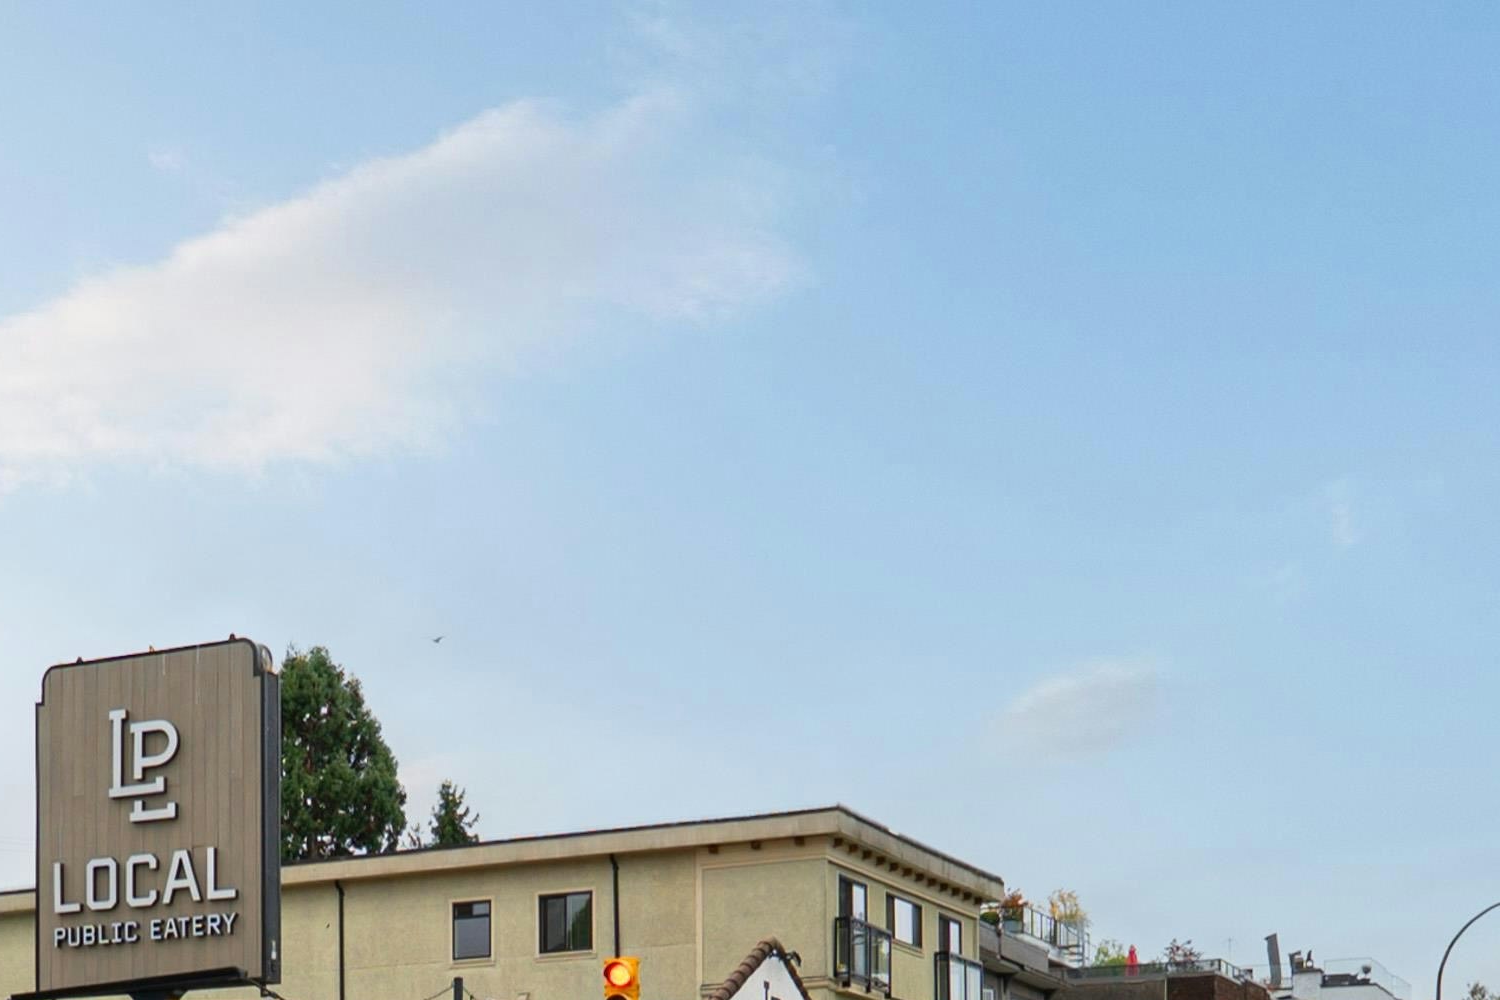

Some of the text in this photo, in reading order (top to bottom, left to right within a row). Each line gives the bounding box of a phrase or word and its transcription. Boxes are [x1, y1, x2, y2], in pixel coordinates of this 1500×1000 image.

[53, 846, 238, 914] LOCAL
[53, 911, 239, 948] PUBLIC EATERY
